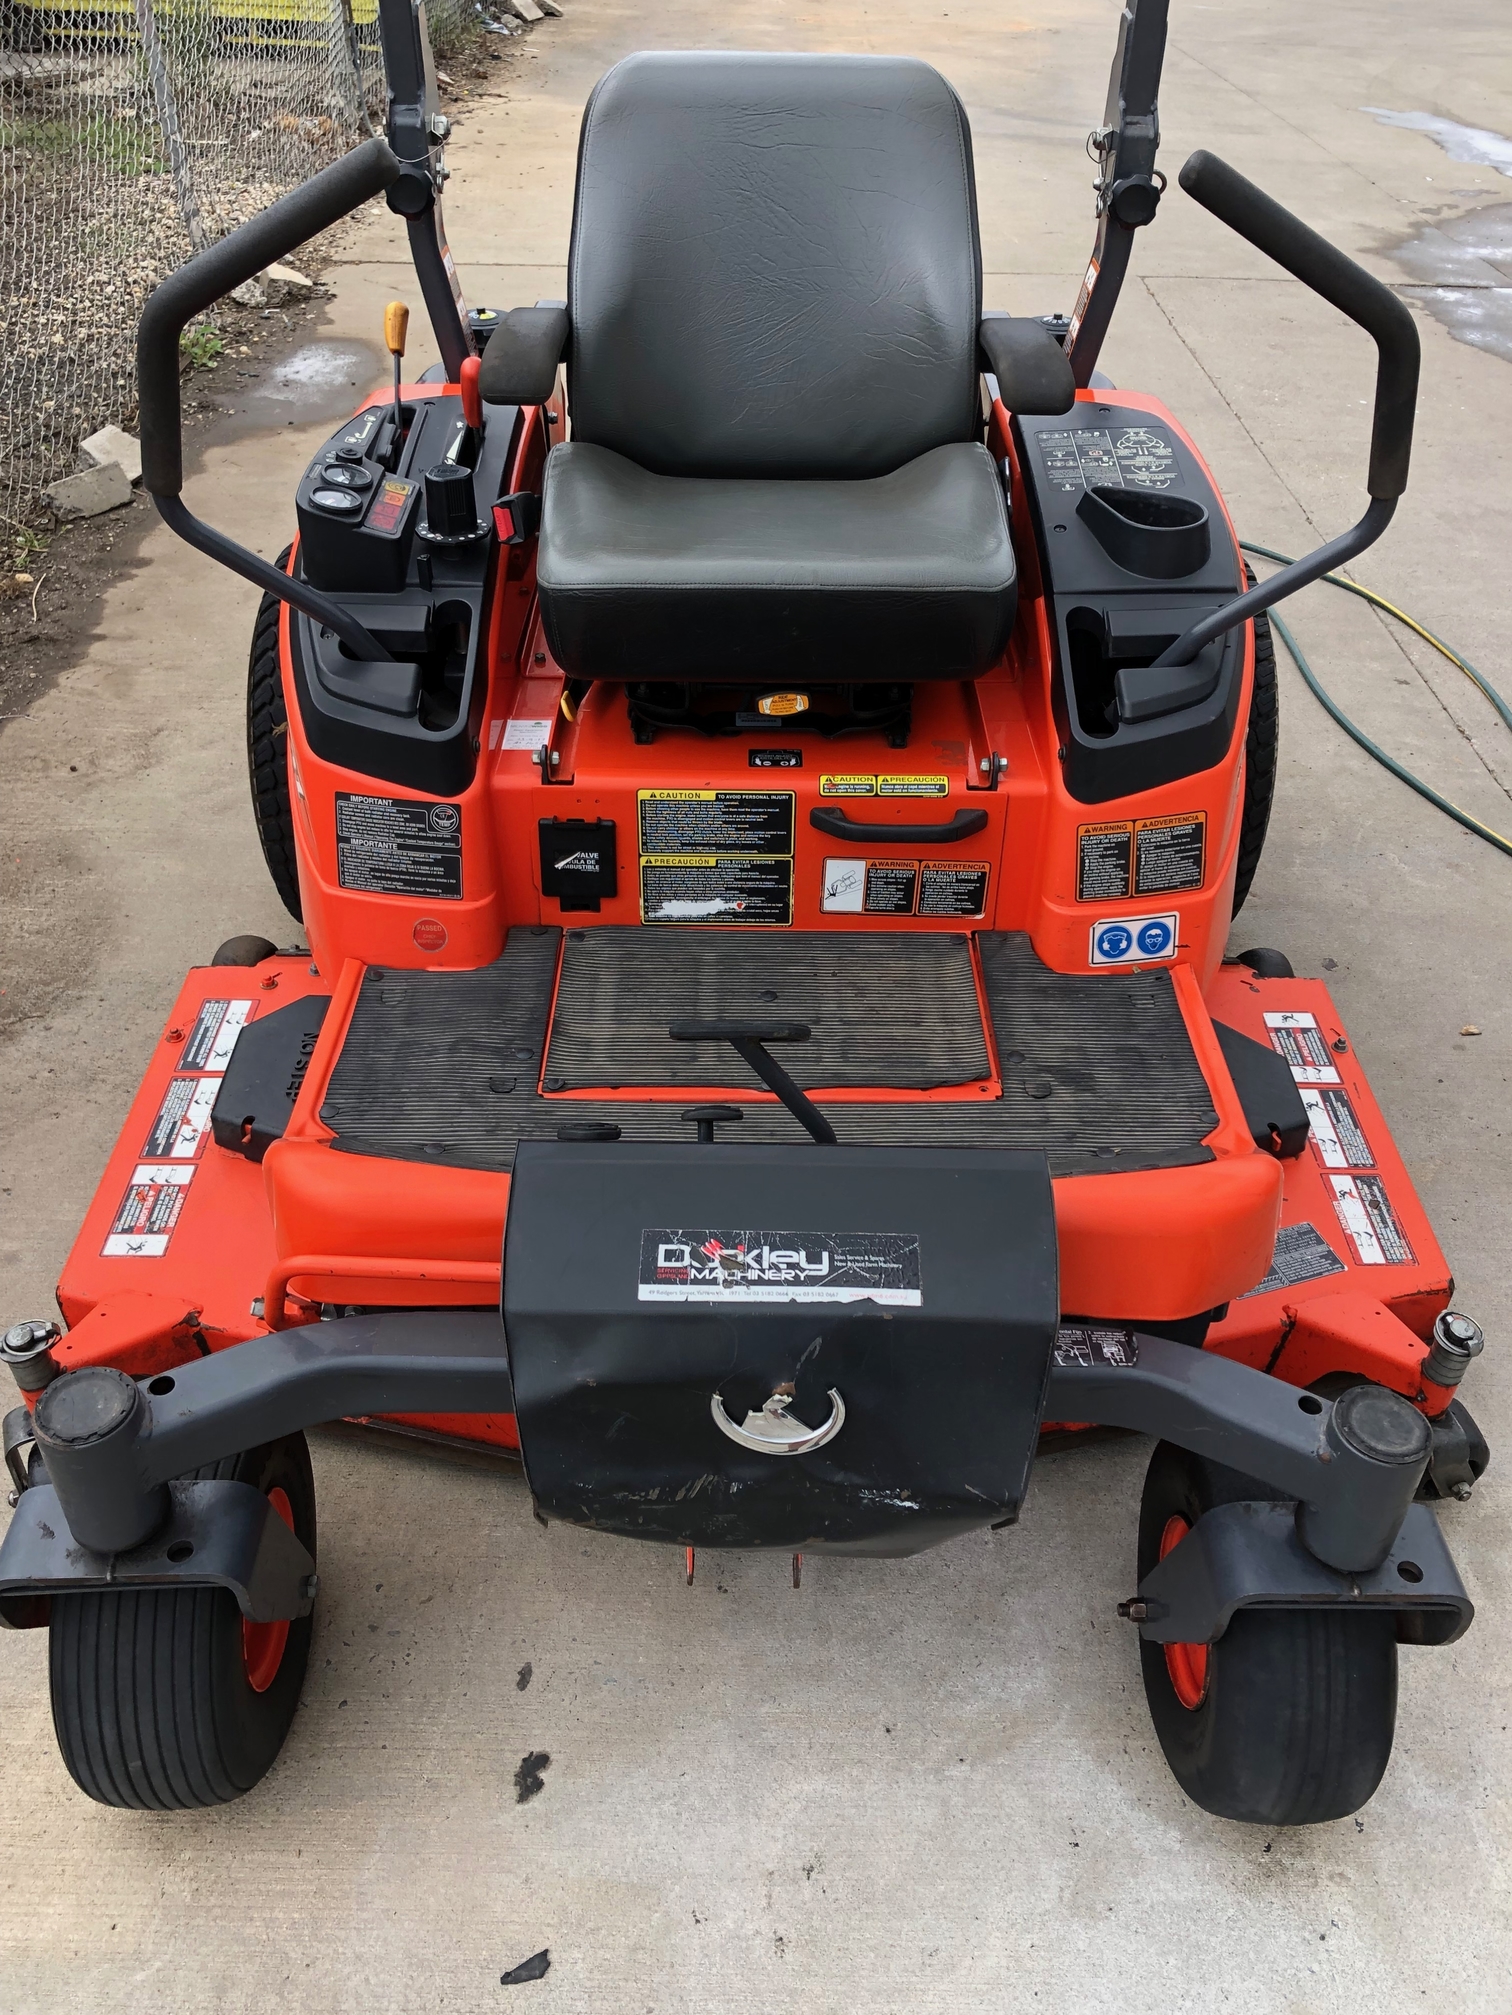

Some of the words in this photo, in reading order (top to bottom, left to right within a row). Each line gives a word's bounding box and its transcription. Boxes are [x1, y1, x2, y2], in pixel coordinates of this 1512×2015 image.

[350, 795, 393, 806] IMPORTANT
[1092, 824, 1127, 833] WARNING
[1149, 815, 1199, 827] ADVERTENCIA
[350, 838, 398, 850] IMPORTANTE
[300, 1032, 320, 1054] NO
[1270, 1032, 1285, 1057] DANGER
[1296, 1033, 1311, 1056] PELIGRO
[136, 1196, 154, 1226] PELIGRO
[166, 1198, 184, 1228] DANGER
[1332, 1201, 1350, 1228] DANGER
[690, 1268, 810, 1280] MACHINERY
